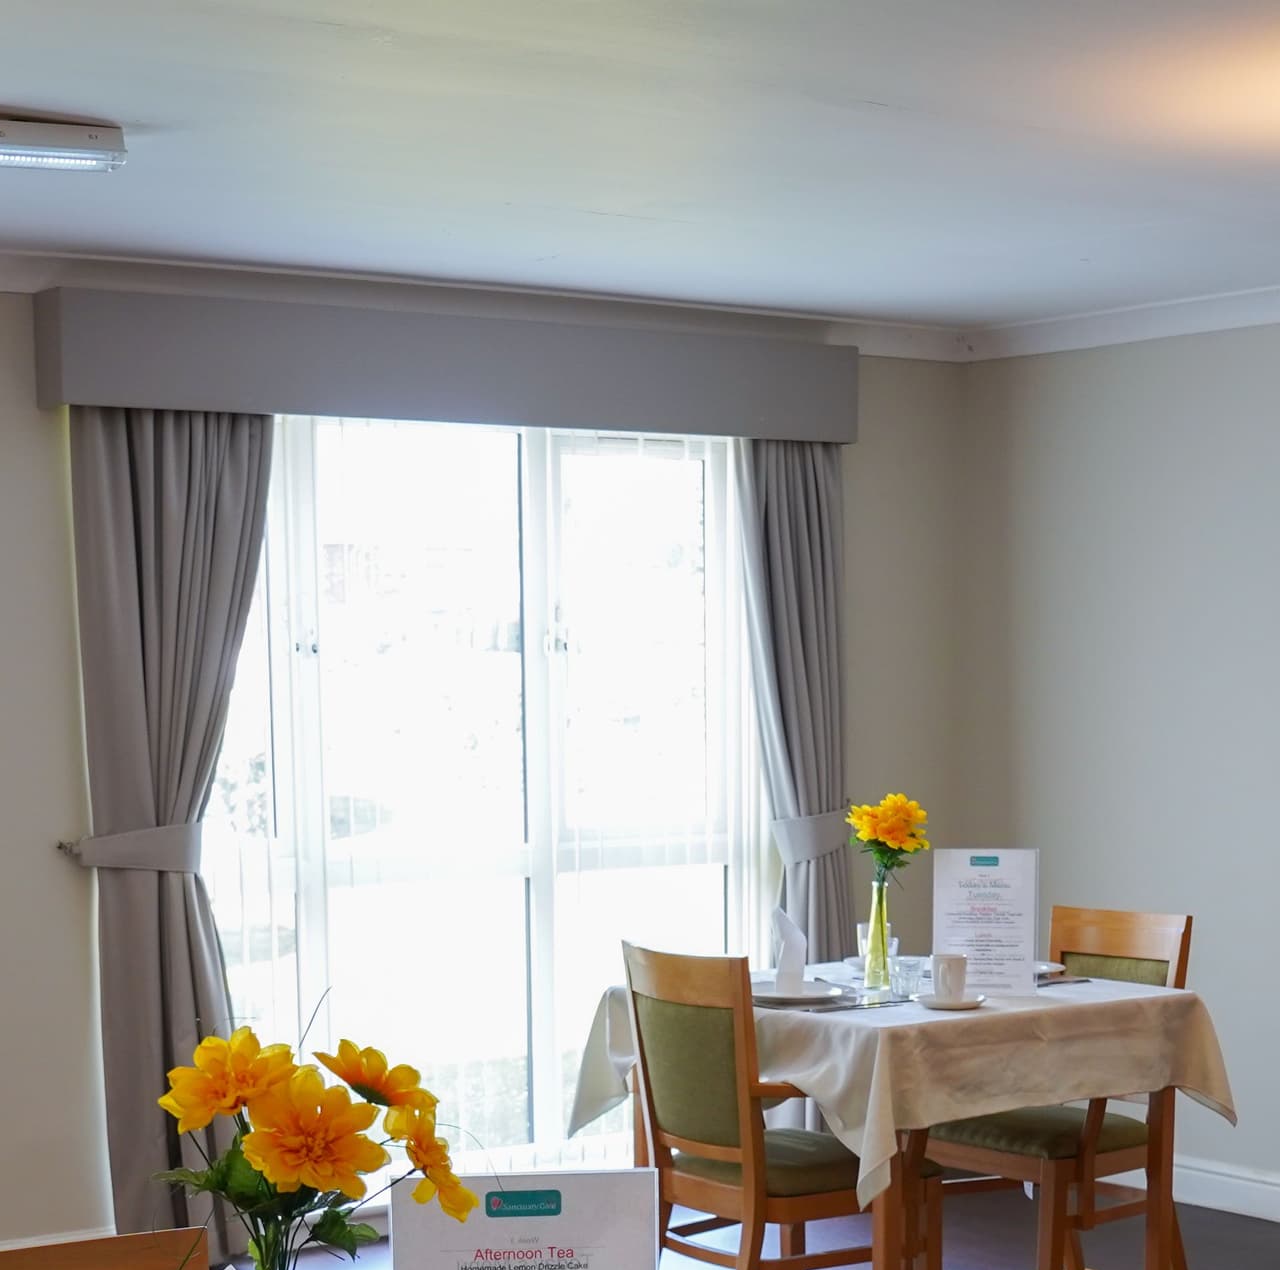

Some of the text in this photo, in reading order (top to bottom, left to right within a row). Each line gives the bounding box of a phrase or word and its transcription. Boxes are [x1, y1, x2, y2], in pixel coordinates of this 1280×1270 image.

[474, 1246, 574, 1261] Afternoon Tea
[538, 1262, 566, 1270] Drizzle
[566, 1261, 589, 1270] Cake
